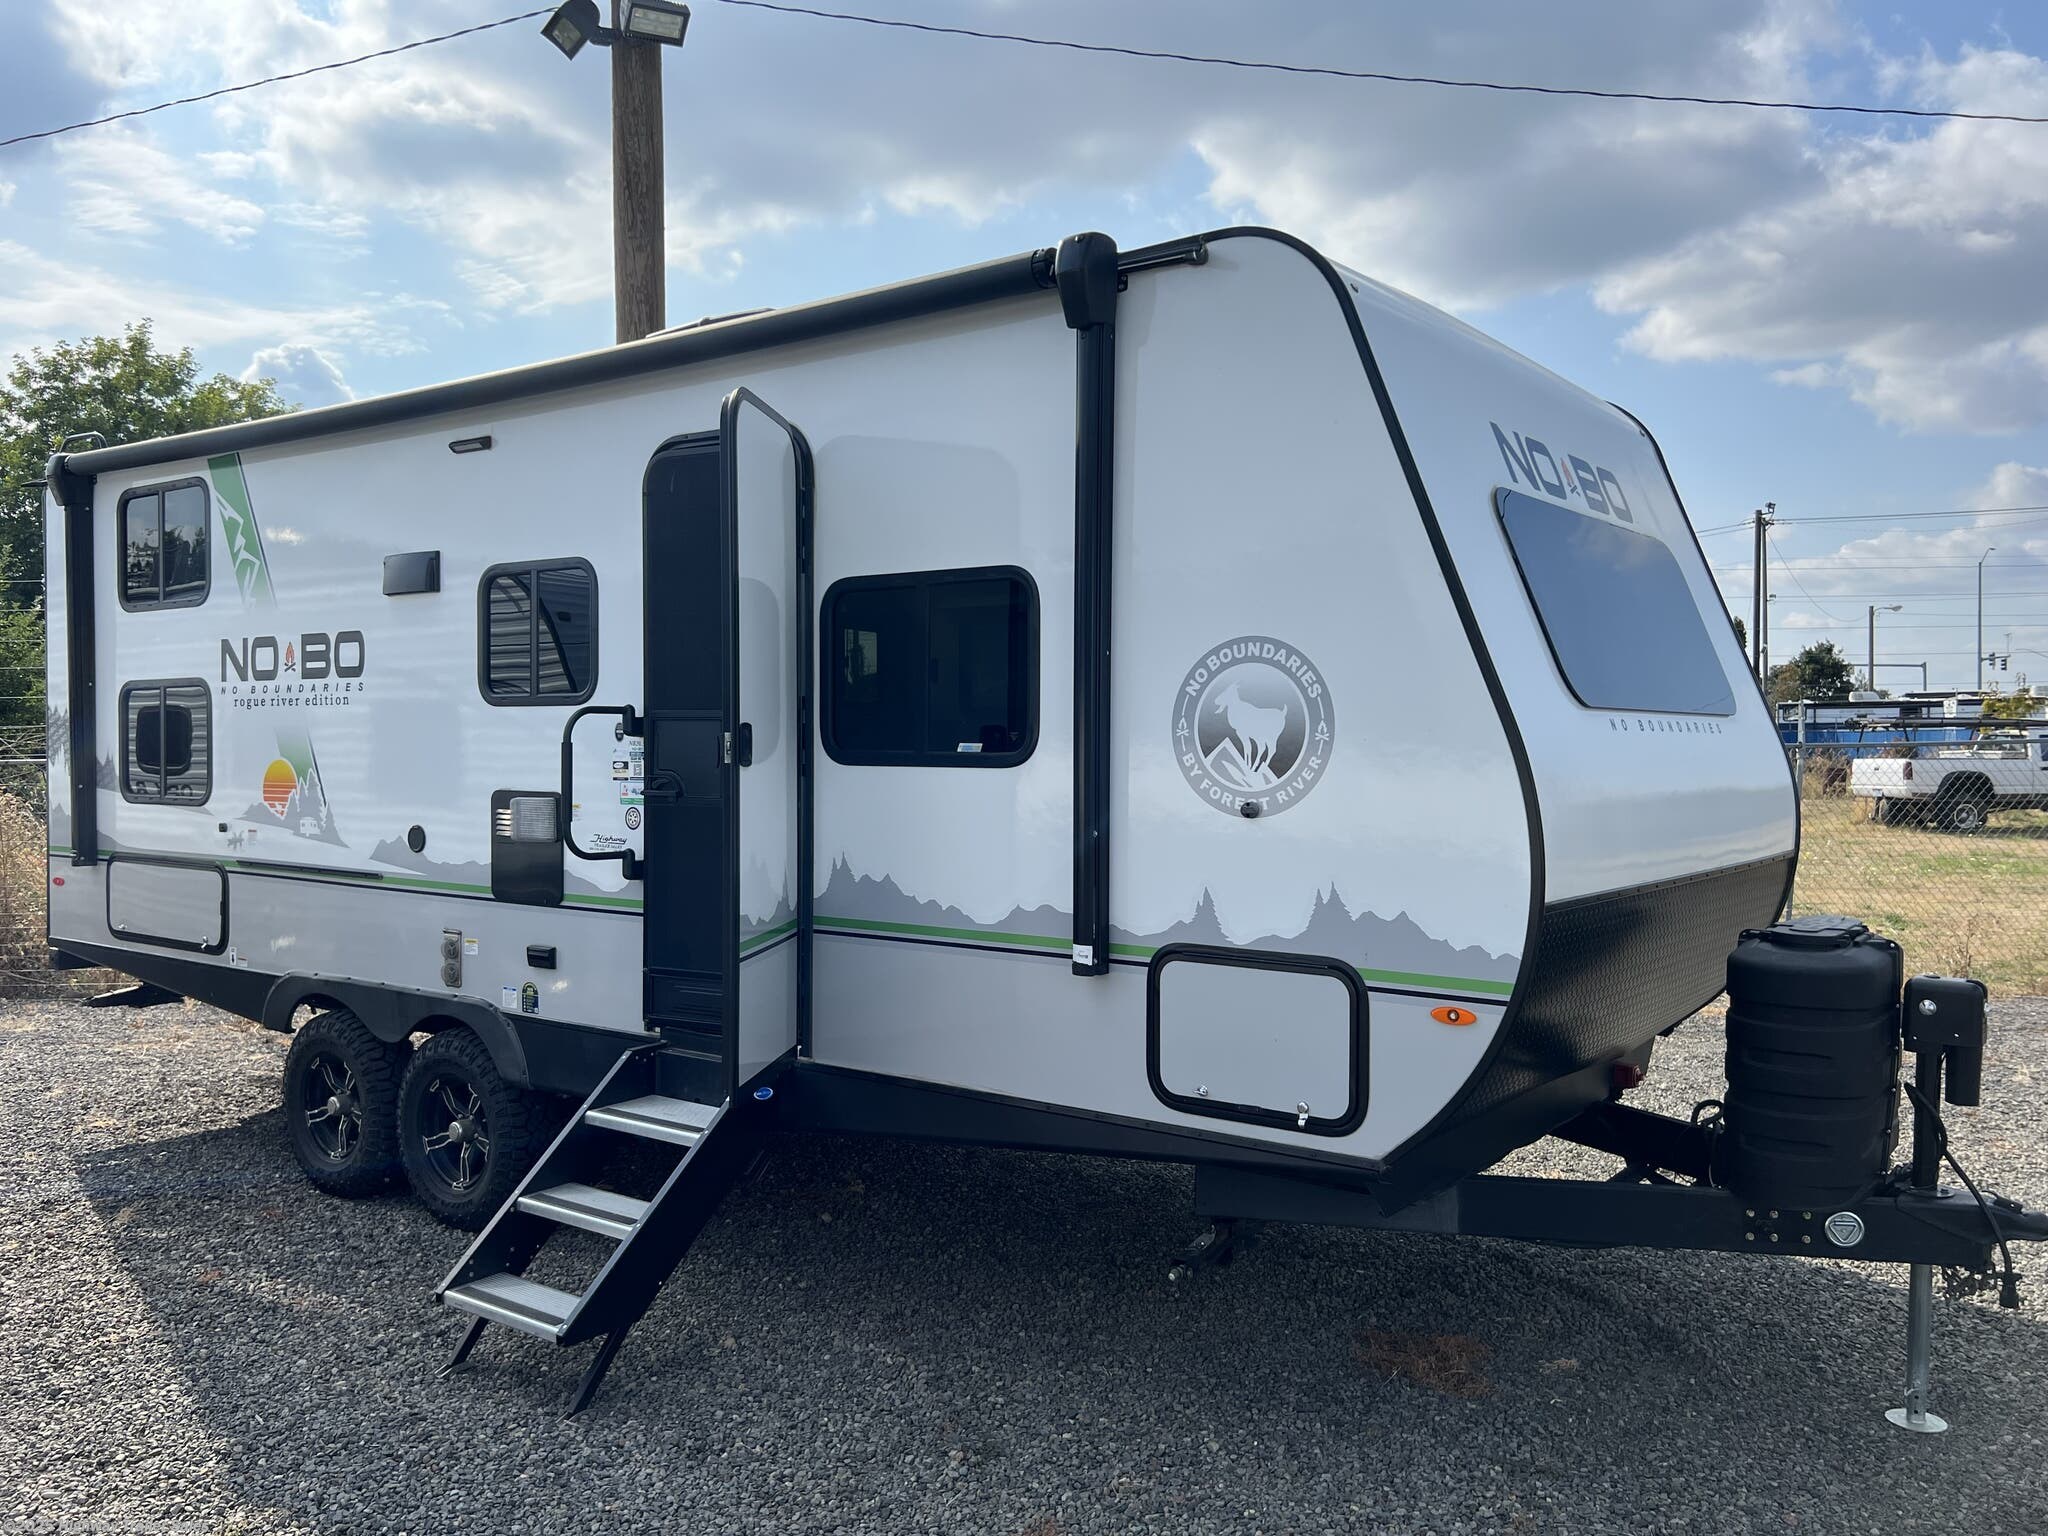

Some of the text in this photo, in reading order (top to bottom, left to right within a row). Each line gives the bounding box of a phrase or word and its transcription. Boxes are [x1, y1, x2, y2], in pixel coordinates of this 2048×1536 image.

[1185, 642, 1322, 698] NO BOUNDARIES
[220, 681, 364, 695] NO BOUNDARIES
[233, 694, 350, 710] rogue river edition
[1608, 718, 1722, 734] NO BOUNDARIES
[1182, 752, 1322, 810] BY FORET RIVER
